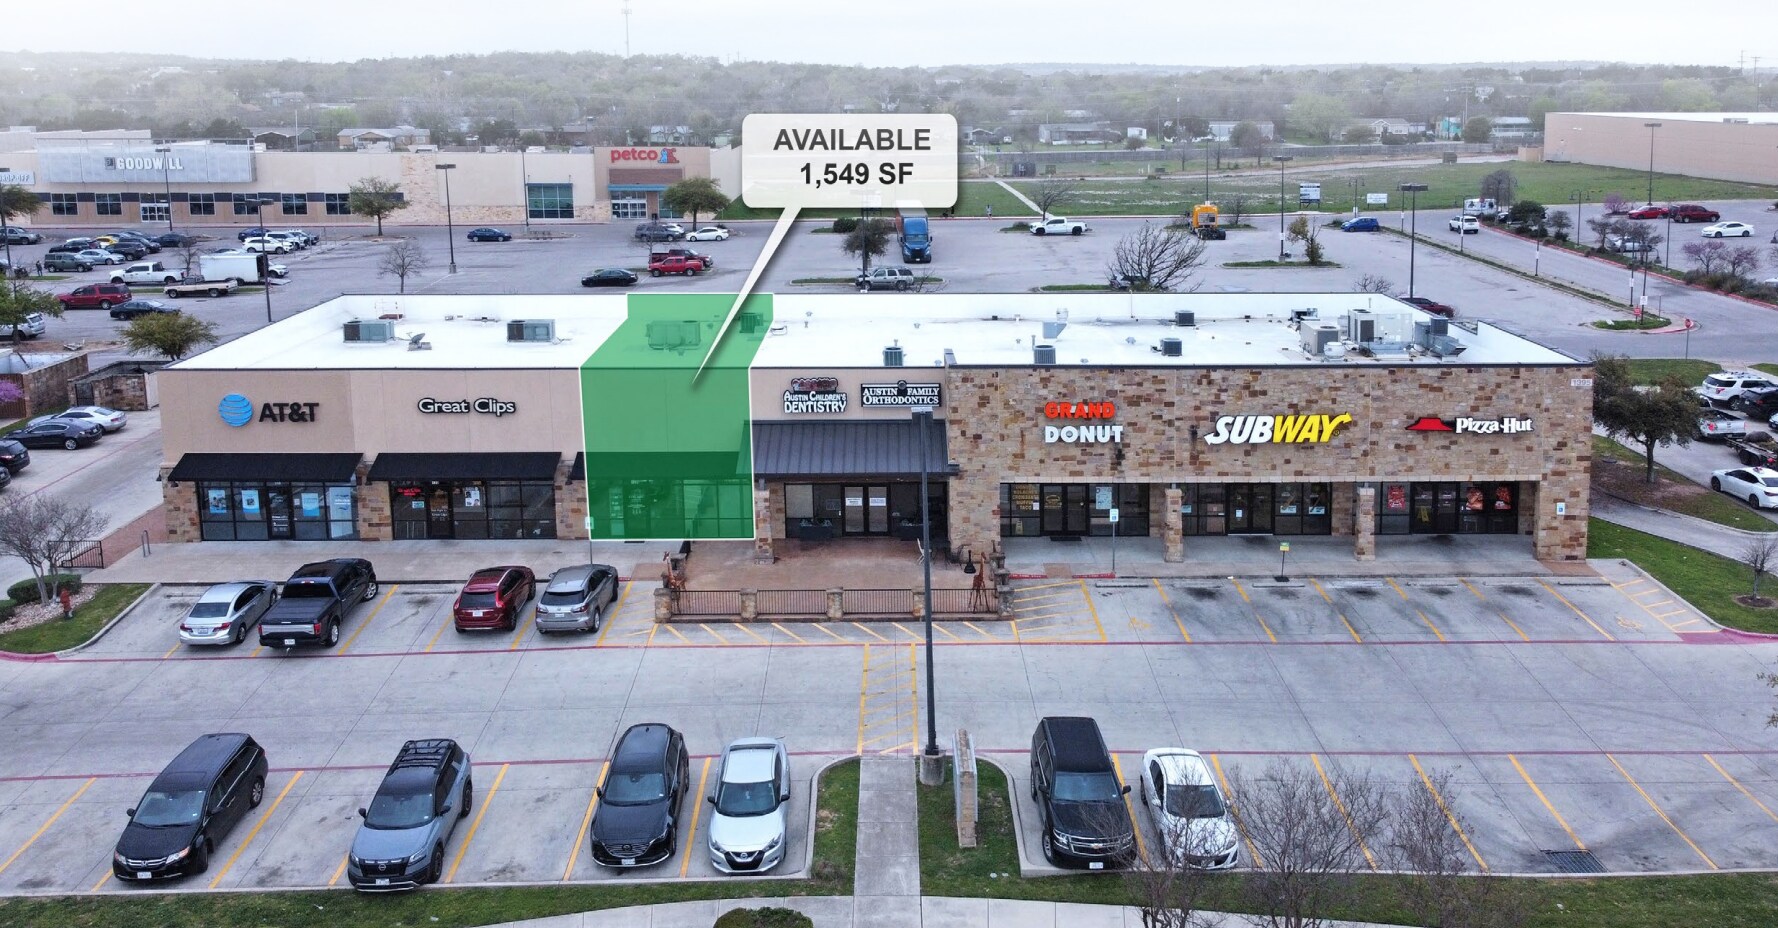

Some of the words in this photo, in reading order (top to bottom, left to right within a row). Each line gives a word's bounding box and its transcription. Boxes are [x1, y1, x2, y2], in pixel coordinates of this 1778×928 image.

[117, 157, 184, 170] GOODWILL
[611, 148, 658, 163] petco
[784, 392, 808, 401] AUSTIN
[863, 388, 898, 396] AUSTIN
[907, 388, 940, 396] FAMILY
[863, 395, 940, 405] ORTHODONTICS
[258, 402, 320, 423] AT&T
[419, 398, 469, 413] Great
[474, 398, 516, 416] Clips
[784, 401, 847, 413] DENTISTRY
[1045, 401, 1116, 419] GRAND
[1203, 412, 1353, 446] SUBWAY
[1455, 417, 1500, 434] Pizza
[1500, 417, 1534, 433] Hut
[1045, 425, 1124, 443] DONUT
